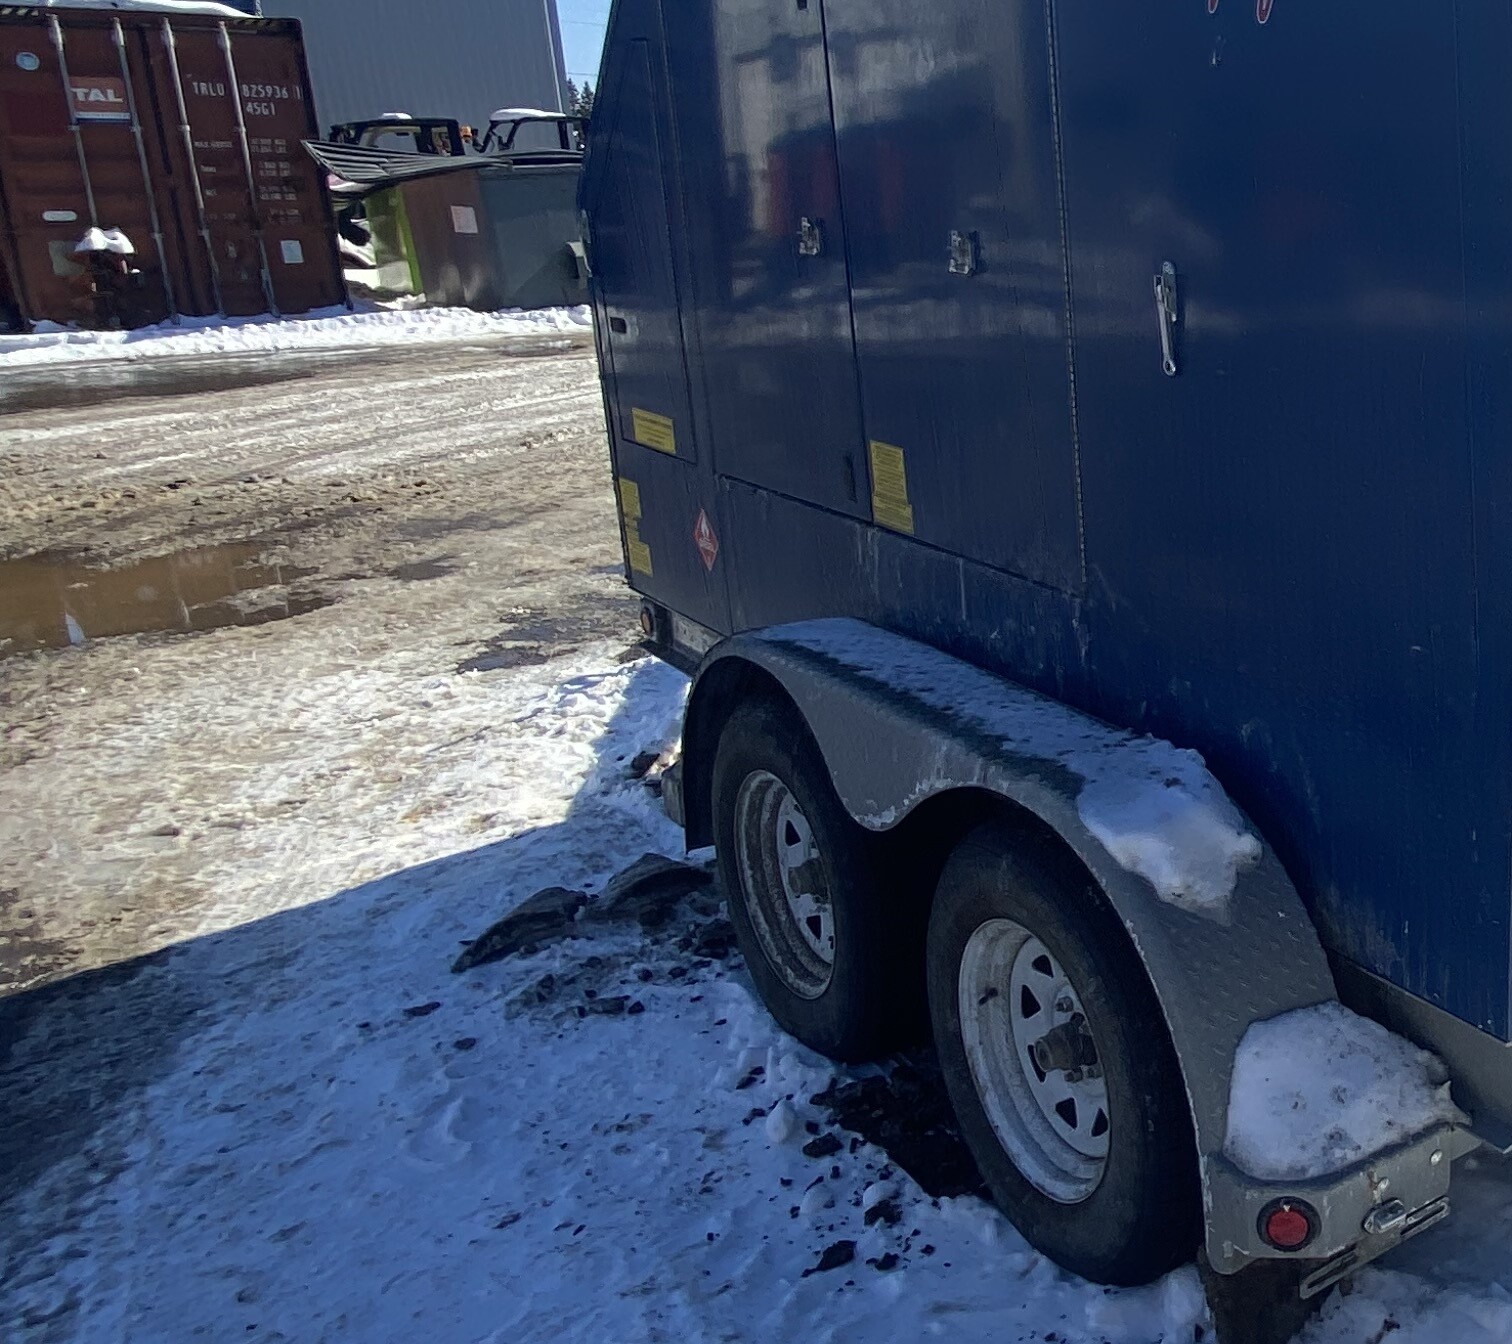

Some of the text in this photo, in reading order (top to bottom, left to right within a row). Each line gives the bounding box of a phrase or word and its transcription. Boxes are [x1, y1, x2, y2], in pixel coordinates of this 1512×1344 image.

[71, 87, 124, 103] TAL
[192, 82, 225, 96] TRLU
[241, 84, 289, 99] 825936
[246, 101, 276, 116] 45G1
